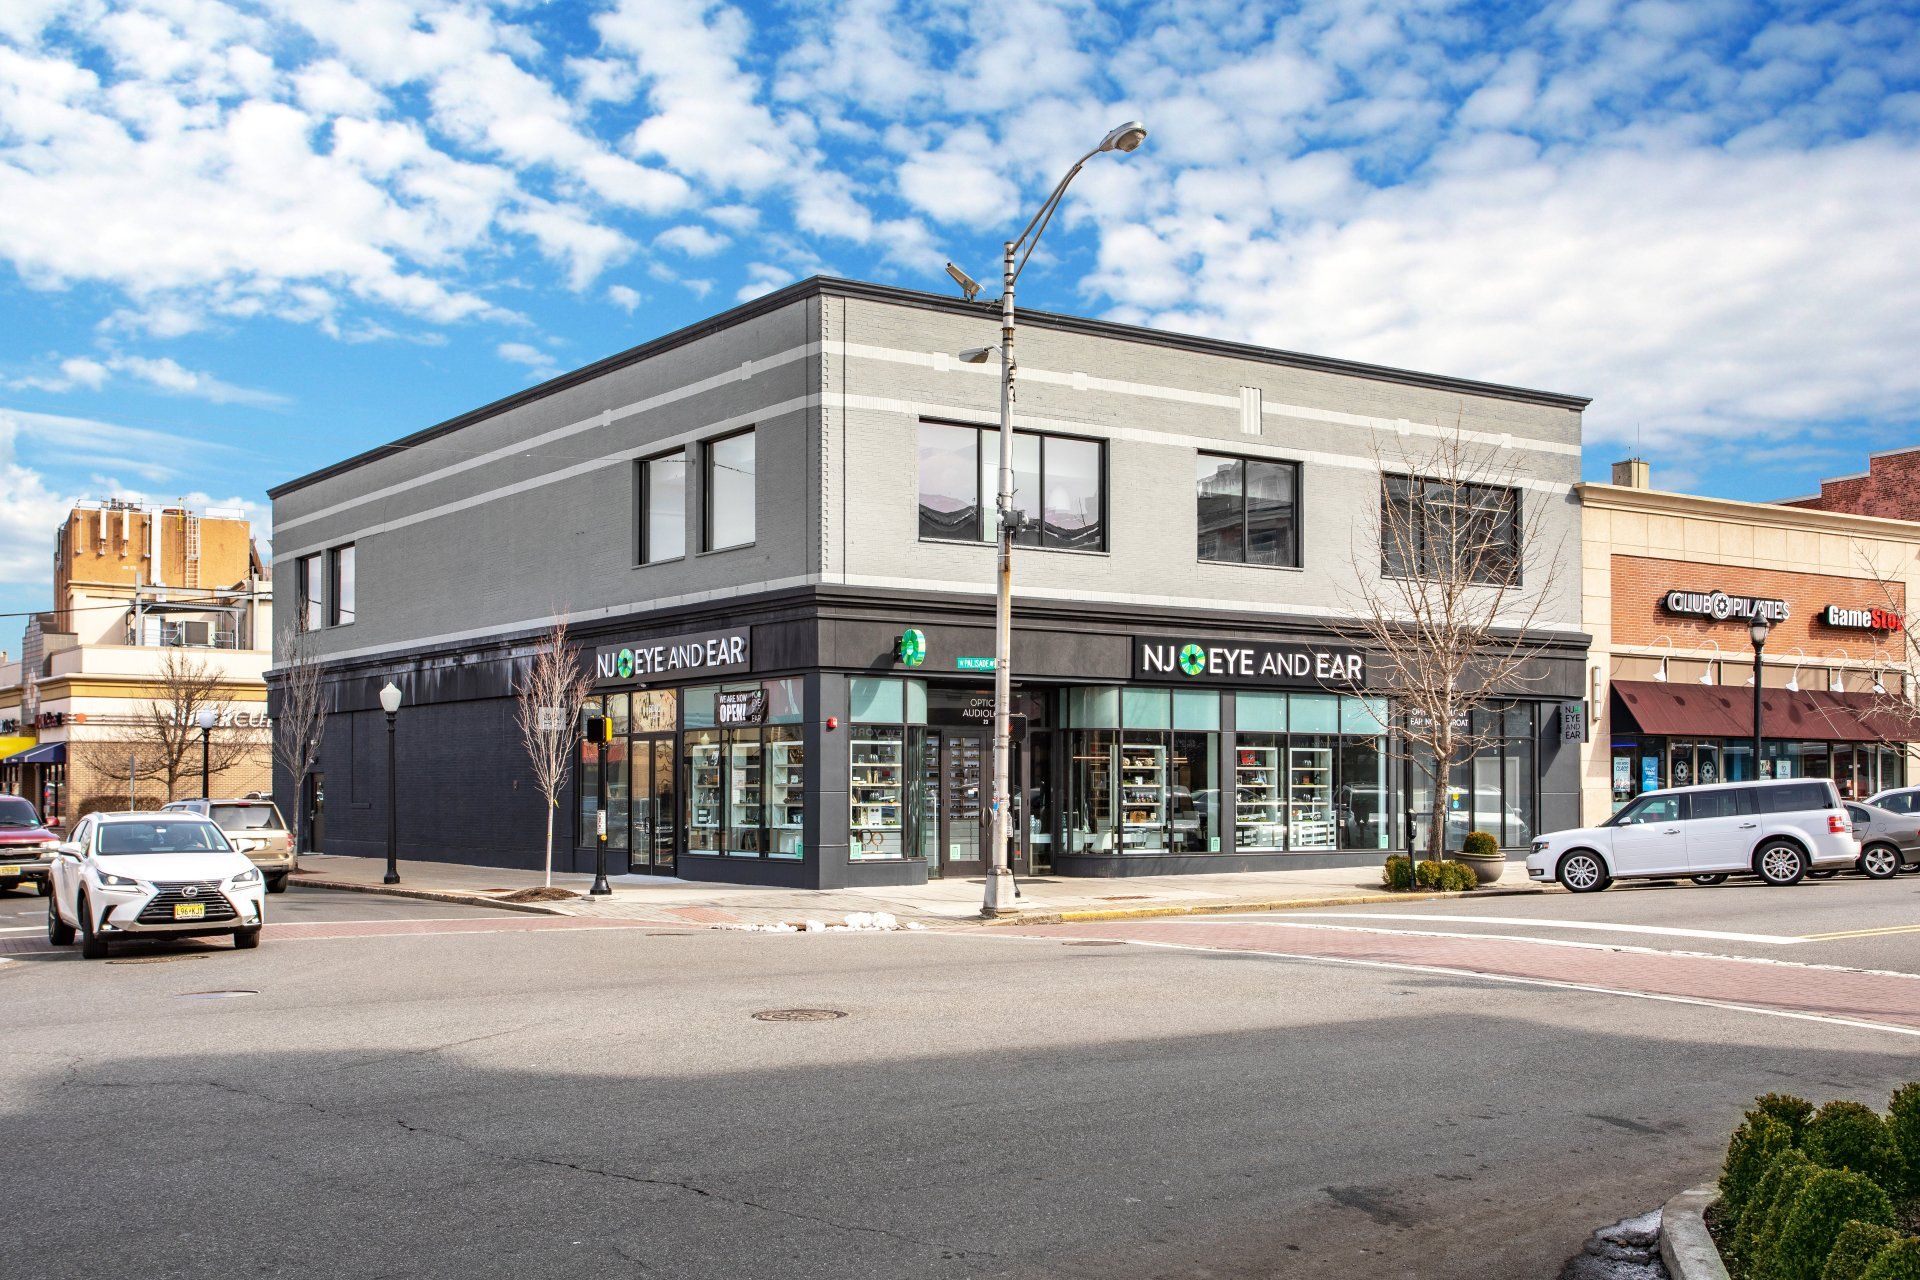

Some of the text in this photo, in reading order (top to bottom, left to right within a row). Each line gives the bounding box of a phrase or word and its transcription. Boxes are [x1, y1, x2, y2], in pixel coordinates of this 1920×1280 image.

[1669, 592, 1791, 619] CLUB PILATES
[598, 636, 745, 679] NJ EYE AND EAR
[1143, 644, 1363, 680] NJ EYE AND EAR
[970, 698, 995, 707] OPTIC
[720, 703, 747, 723] OPEN!
[1565, 713, 1581, 723] EYE
[1565, 723, 1581, 731] AND
[1565, 730, 1581, 740] EAR
